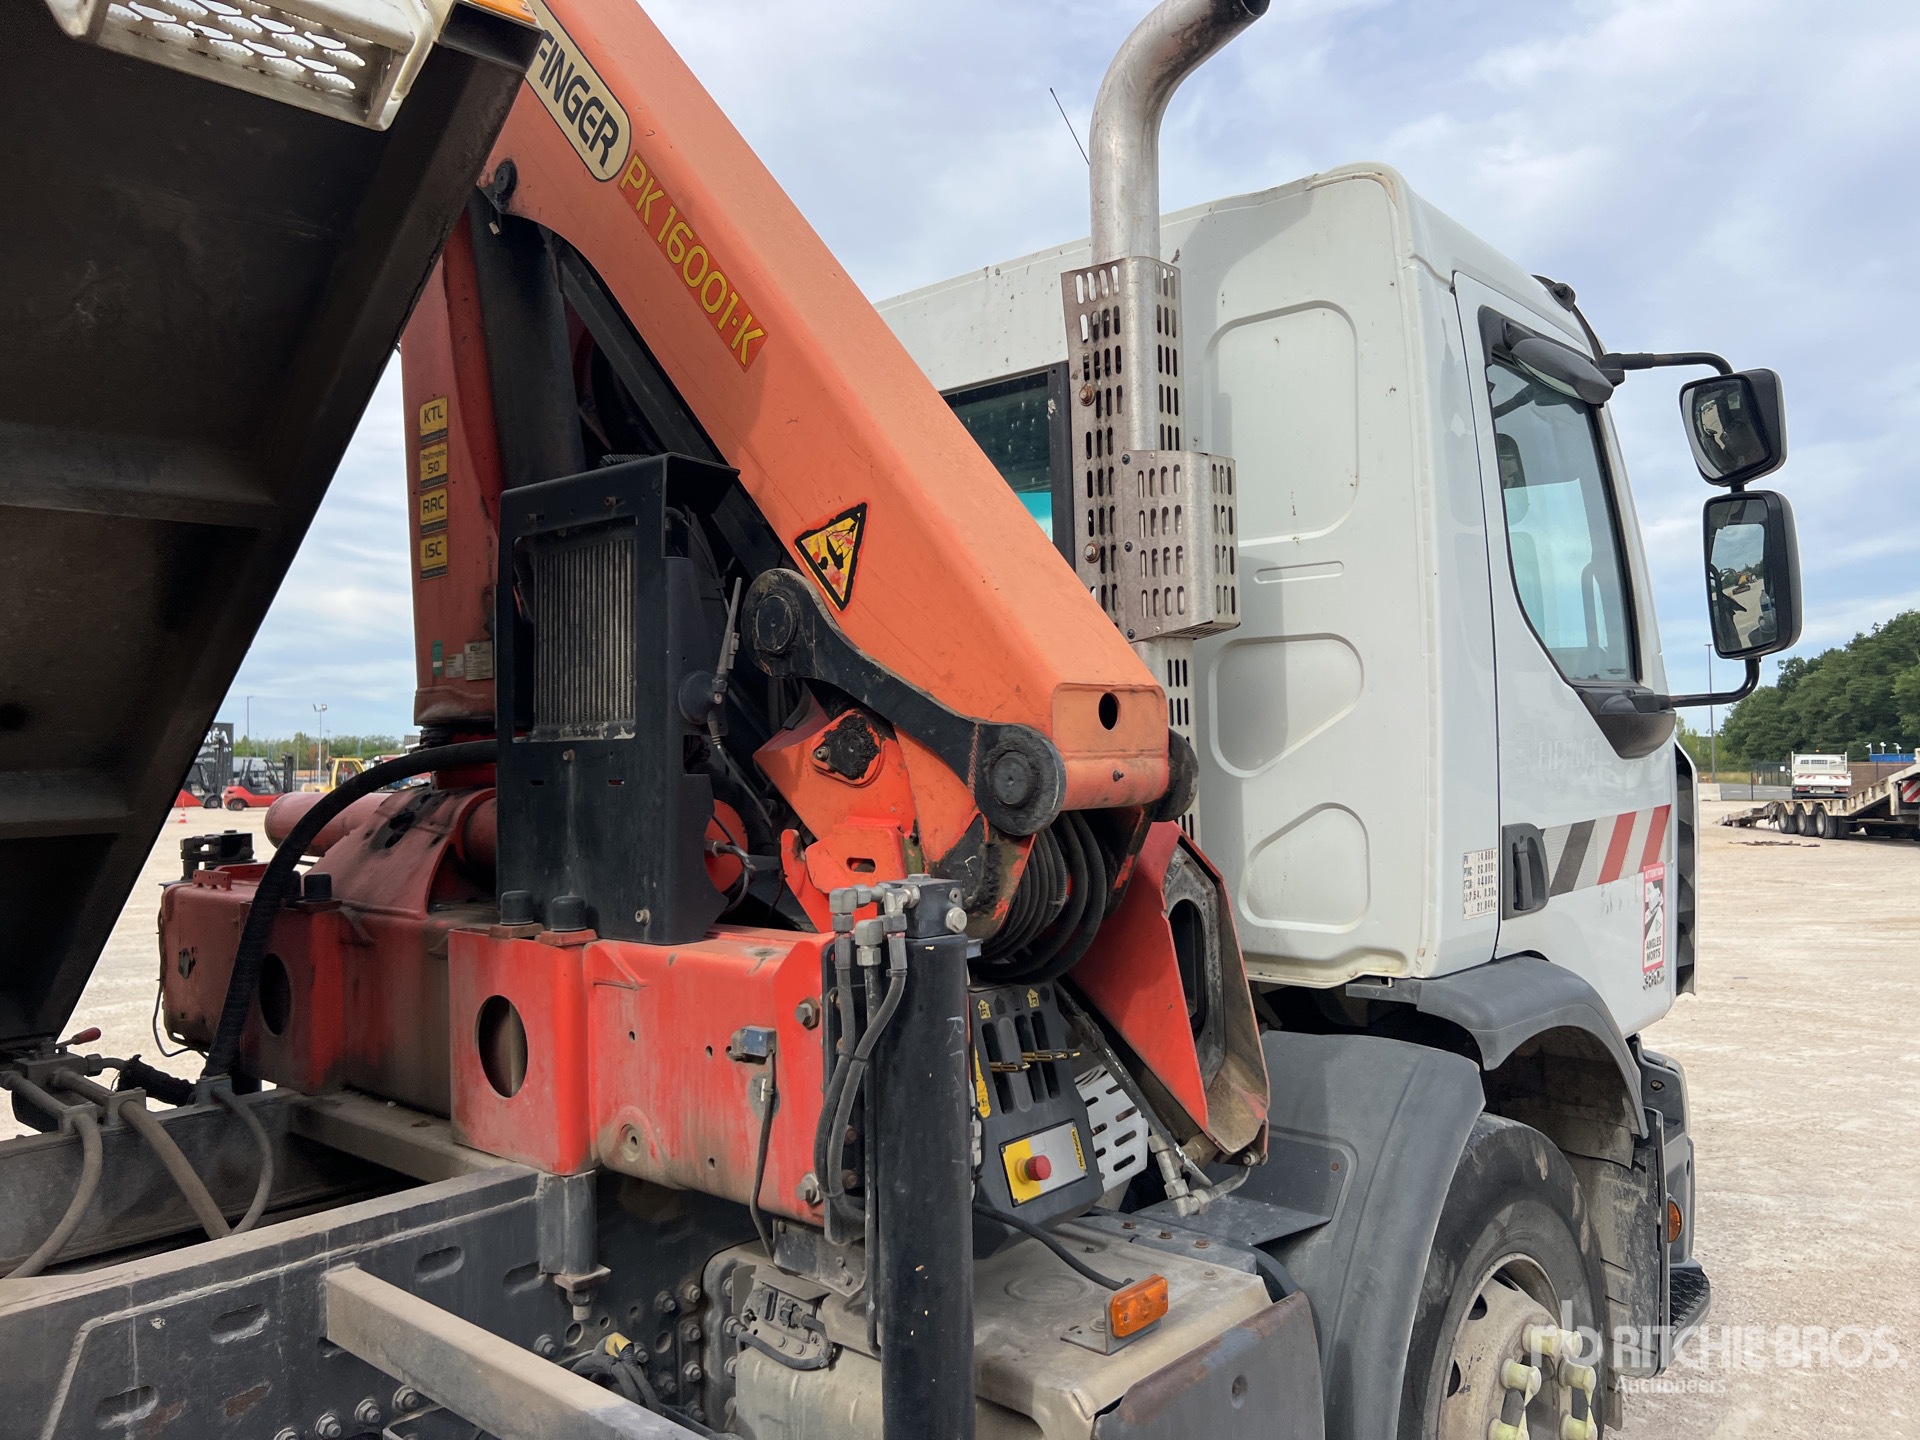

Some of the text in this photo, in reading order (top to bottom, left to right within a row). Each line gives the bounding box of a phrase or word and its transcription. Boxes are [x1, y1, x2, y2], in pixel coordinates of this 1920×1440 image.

[620, 153, 664, 226] PK
[424, 405, 444, 424] KTL
[428, 461, 440, 475] 50
[423, 495, 445, 514] RRC
[425, 541, 442, 559] ISC
[1646, 935, 1662, 951] ANGLES
[1646, 947, 1661, 963] MORTS
